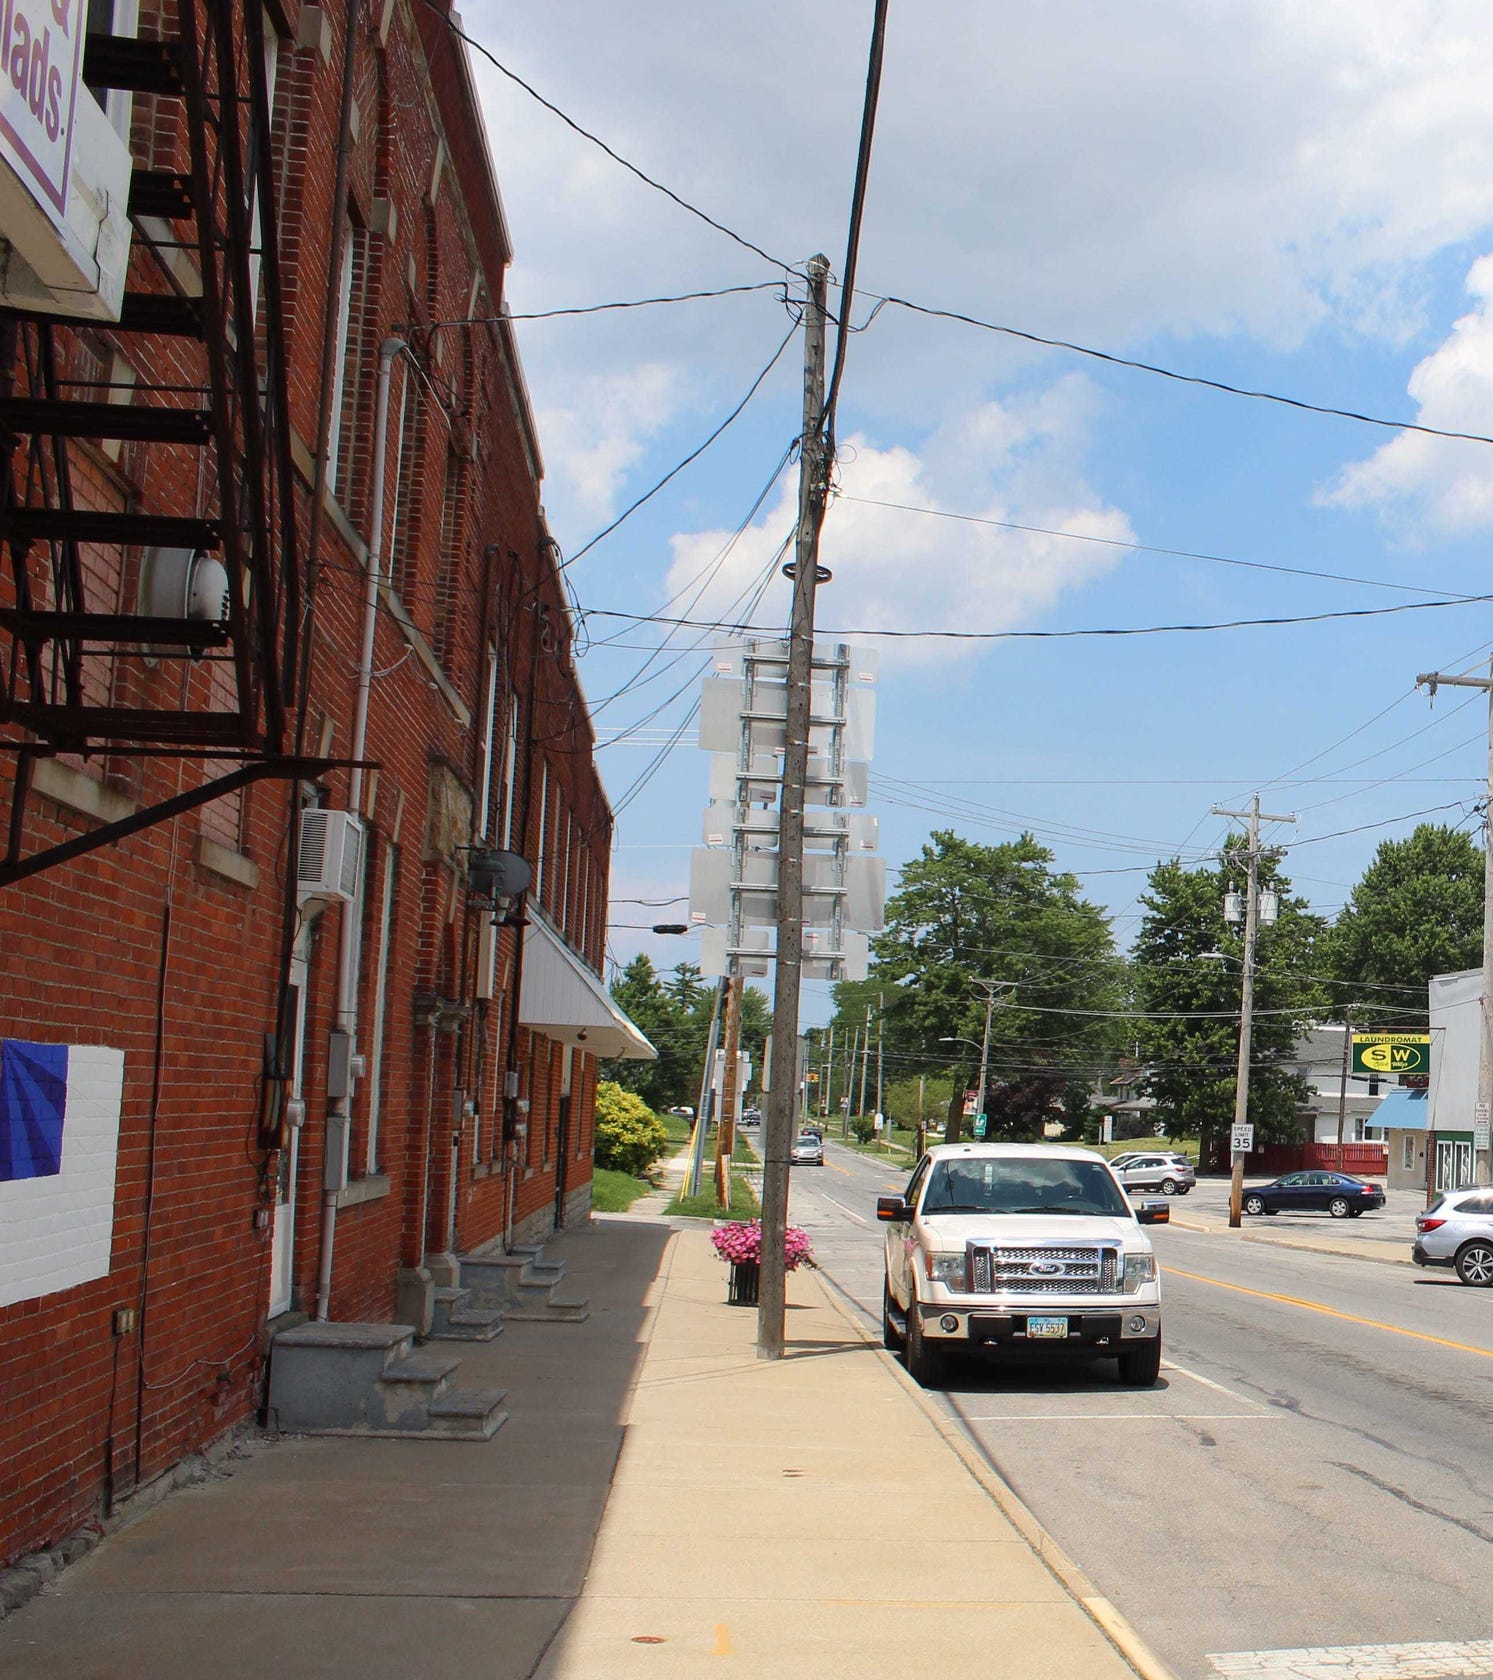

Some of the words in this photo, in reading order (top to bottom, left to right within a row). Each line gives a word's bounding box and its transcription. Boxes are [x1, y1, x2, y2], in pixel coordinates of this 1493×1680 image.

[0, 0, 62, 143] lads
[1371, 1049, 1387, 1061] S
[1392, 1049, 1411, 1062] W
[1233, 1137, 1251, 1149] 35
